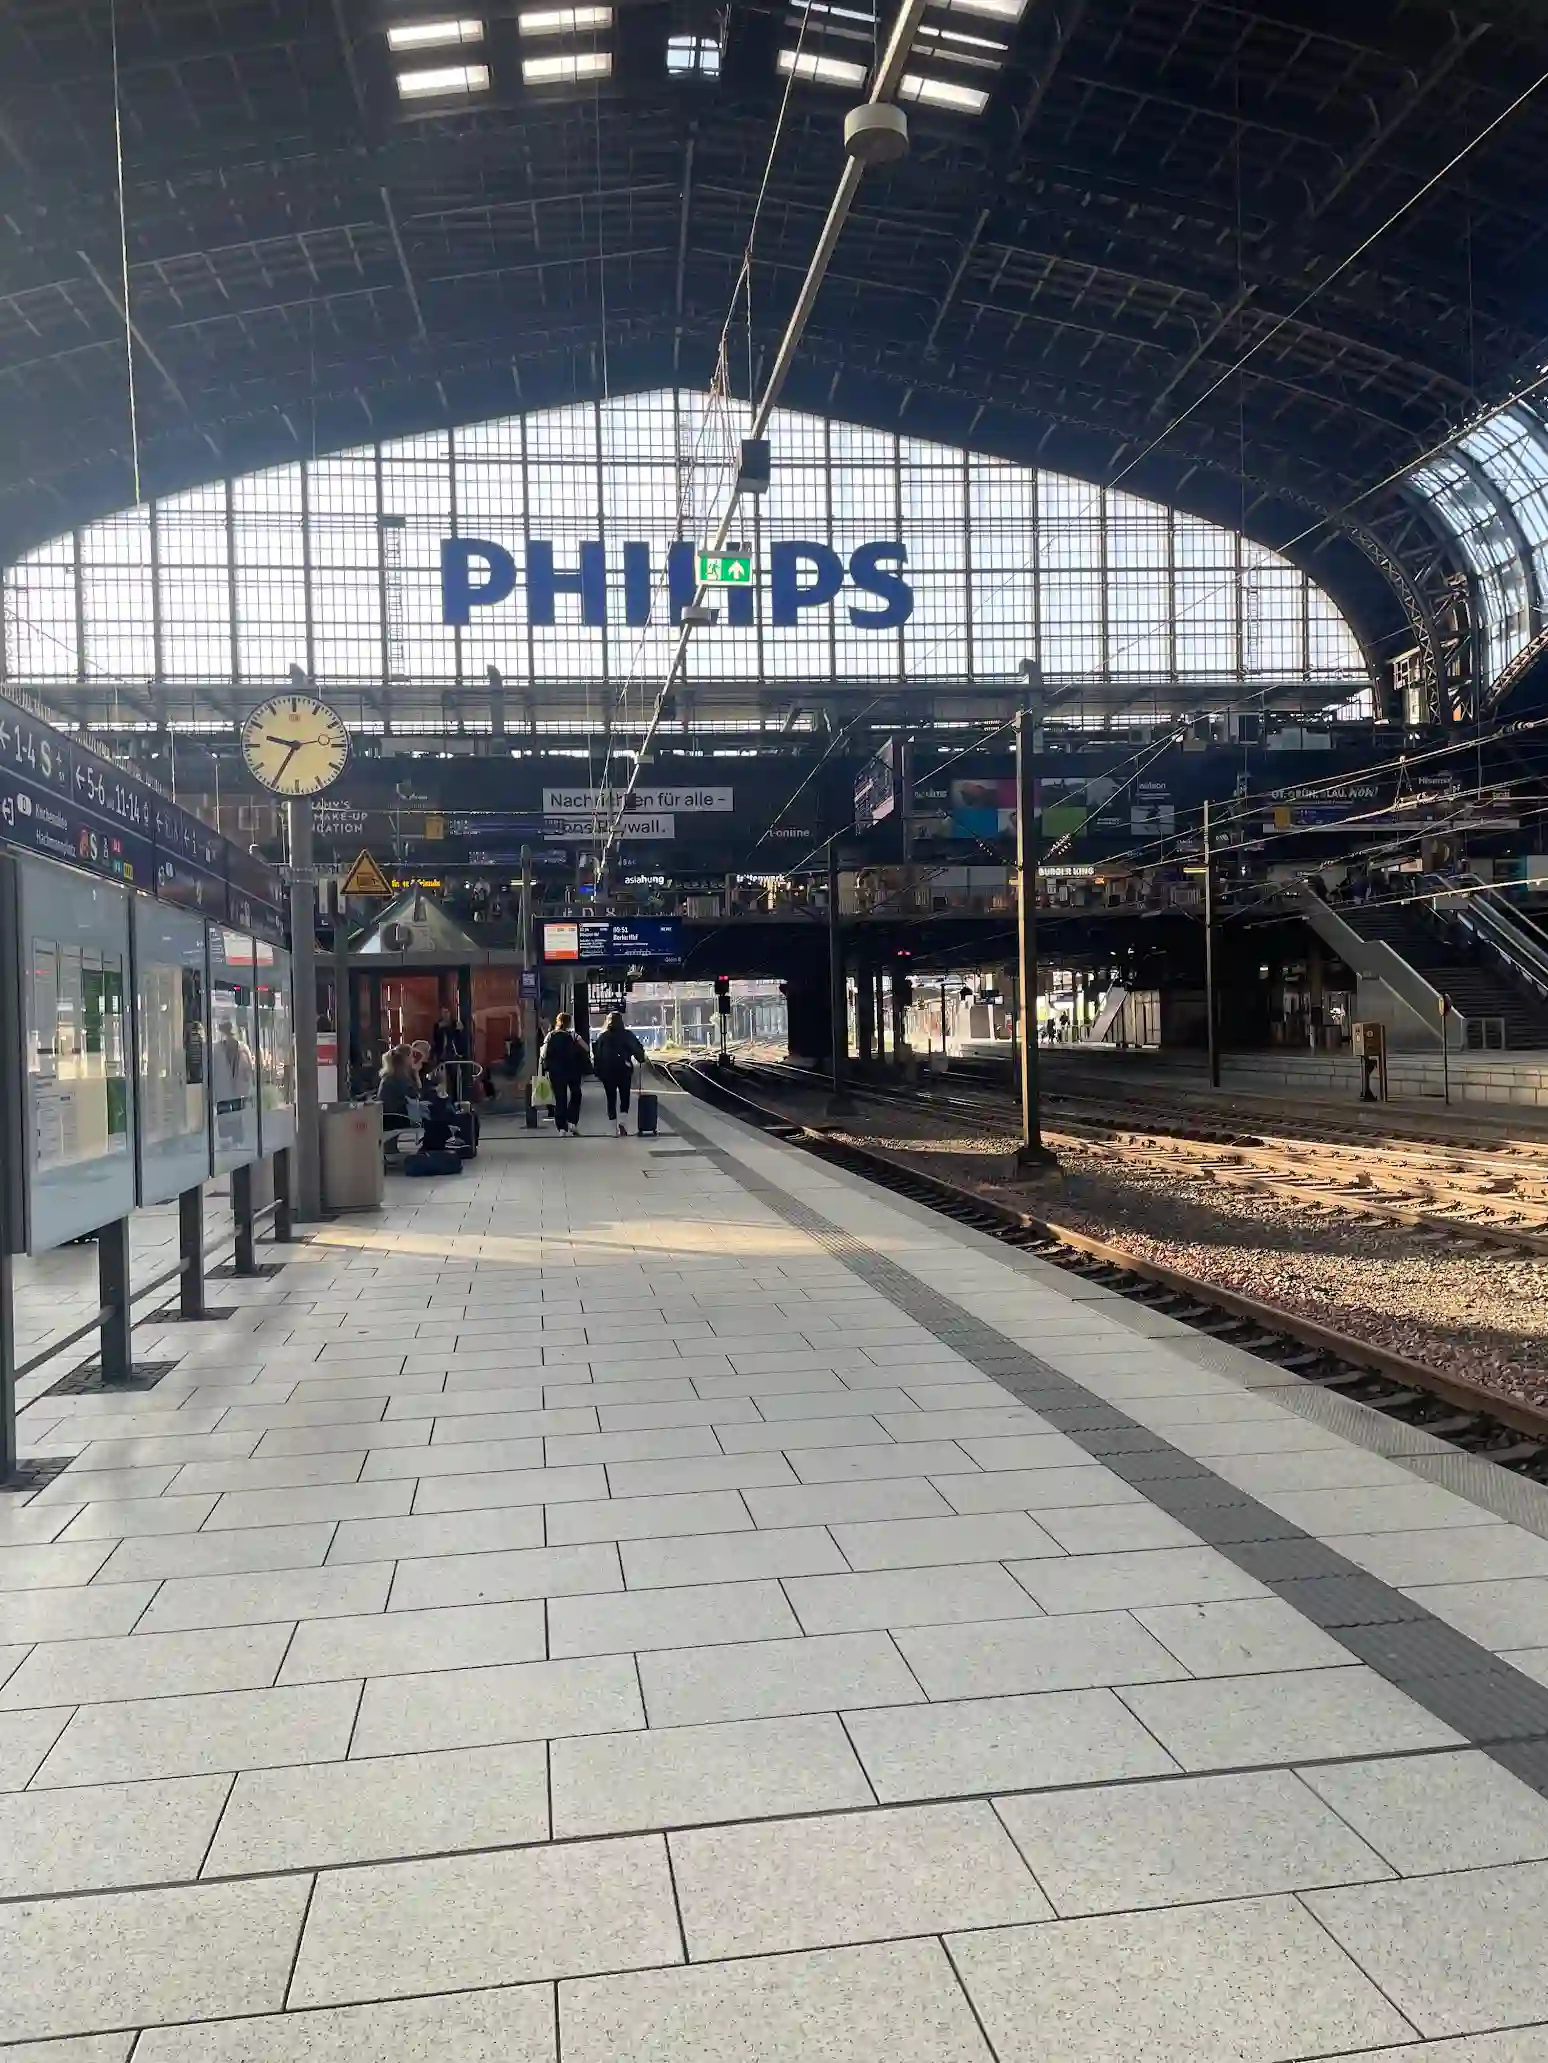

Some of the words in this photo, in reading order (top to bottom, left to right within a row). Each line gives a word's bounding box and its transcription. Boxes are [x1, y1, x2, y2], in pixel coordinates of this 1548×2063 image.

[440, 537, 915, 630] PHILIPS
[550, 792, 653, 807] Nachrichen
[658, 792, 680, 807] für
[684, 792, 714, 807] alle
[313, 811, 368, 821] MAKE-UP
[769, 827, 811, 839] t-online
[1073, 866, 1095, 876] KING
